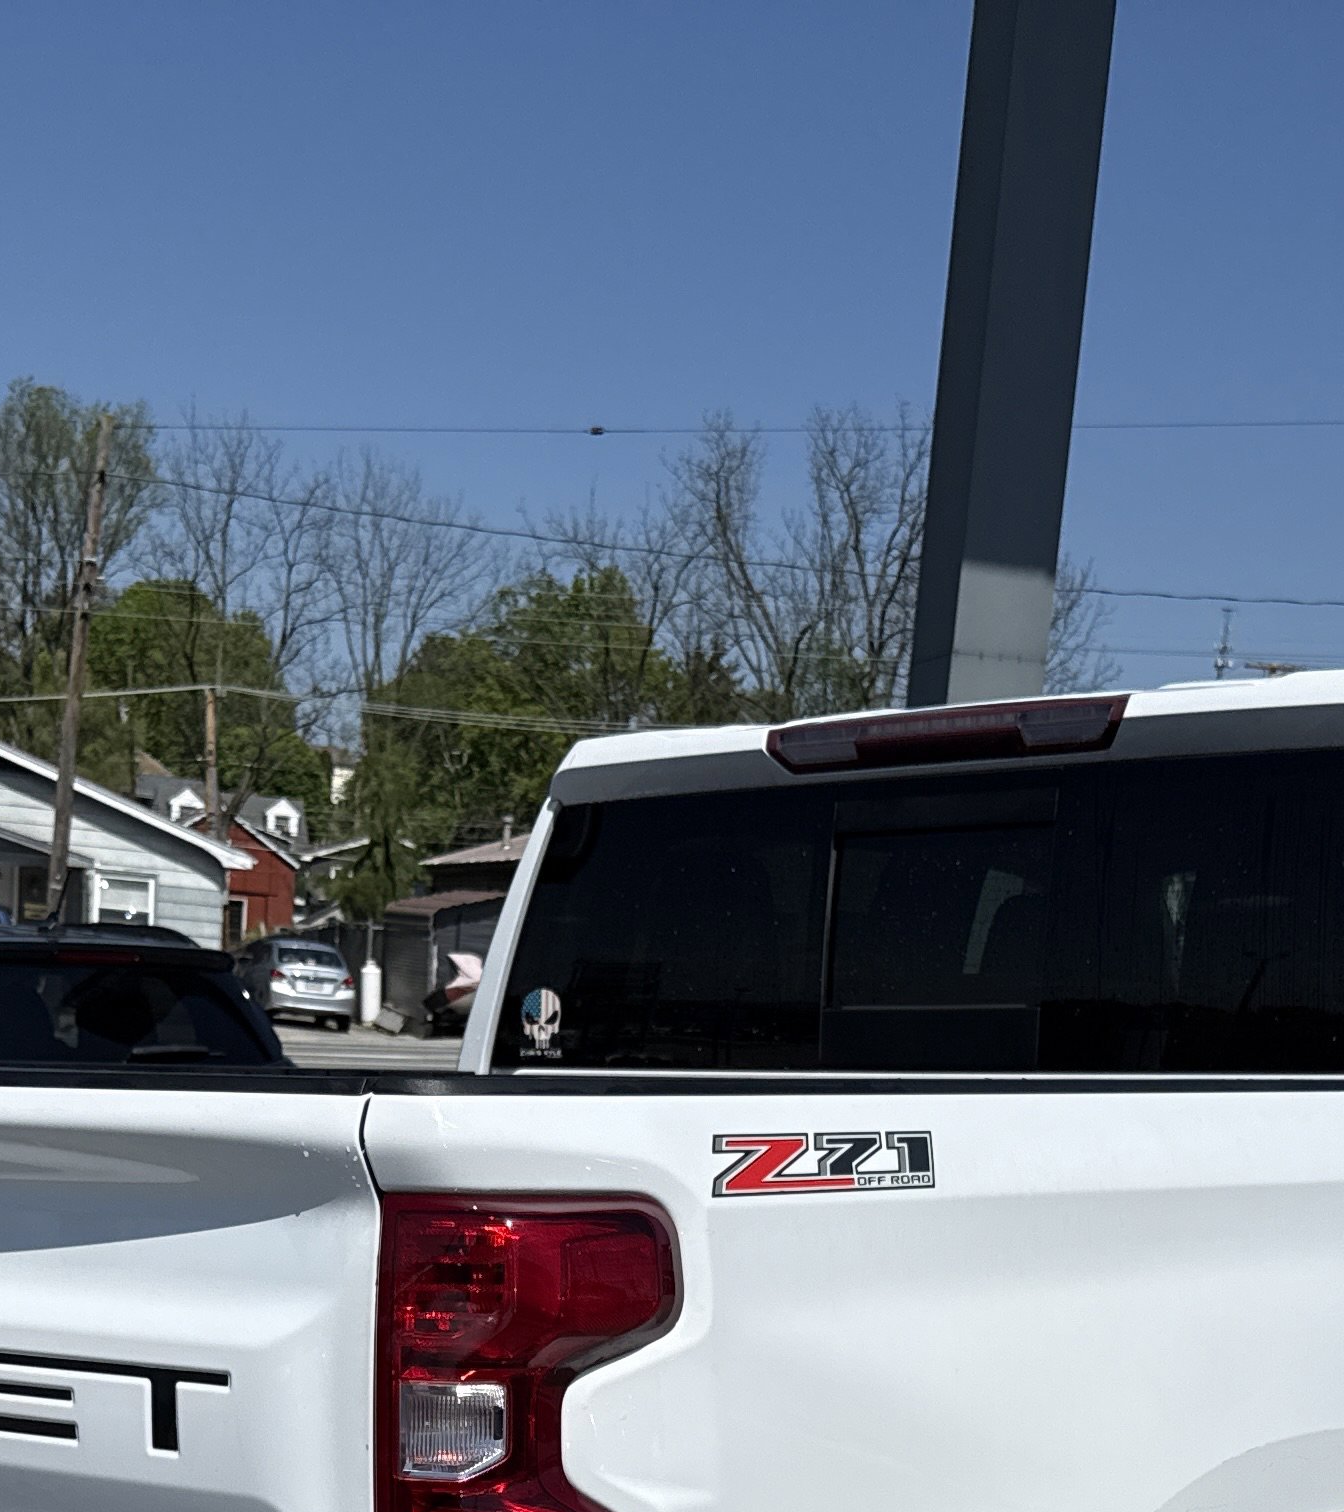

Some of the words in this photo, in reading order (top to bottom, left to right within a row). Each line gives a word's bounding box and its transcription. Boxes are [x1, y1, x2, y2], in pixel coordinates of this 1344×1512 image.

[712, 1131, 935, 1198] Z71
[857, 1176, 886, 1187] OFF
[890, 1175, 931, 1186] ROAD
